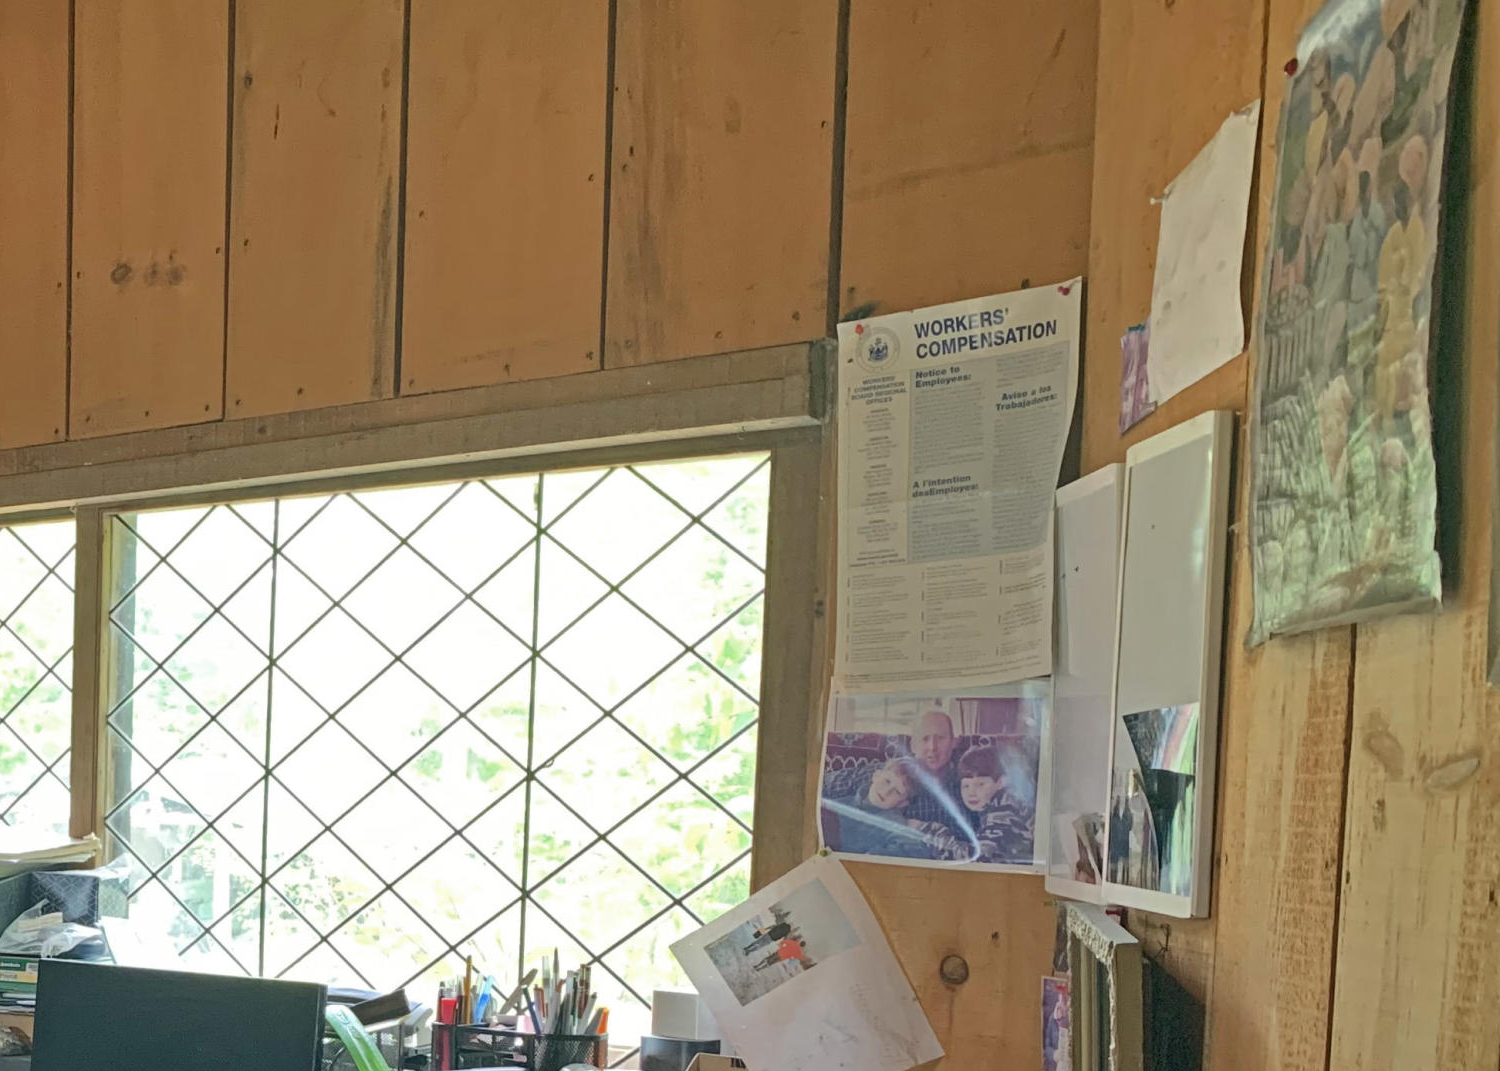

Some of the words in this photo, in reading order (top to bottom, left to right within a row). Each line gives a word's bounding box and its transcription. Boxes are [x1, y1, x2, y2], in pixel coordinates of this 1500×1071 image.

[914, 308, 1008, 339] WORKERS'
[915, 319, 1058, 360] COMPENSATION
[915, 369, 947, 379] Notice
[950, 366, 960, 375] to
[915, 373, 972, 388] Employees:
[1001, 389, 1028, 401] Aviso
